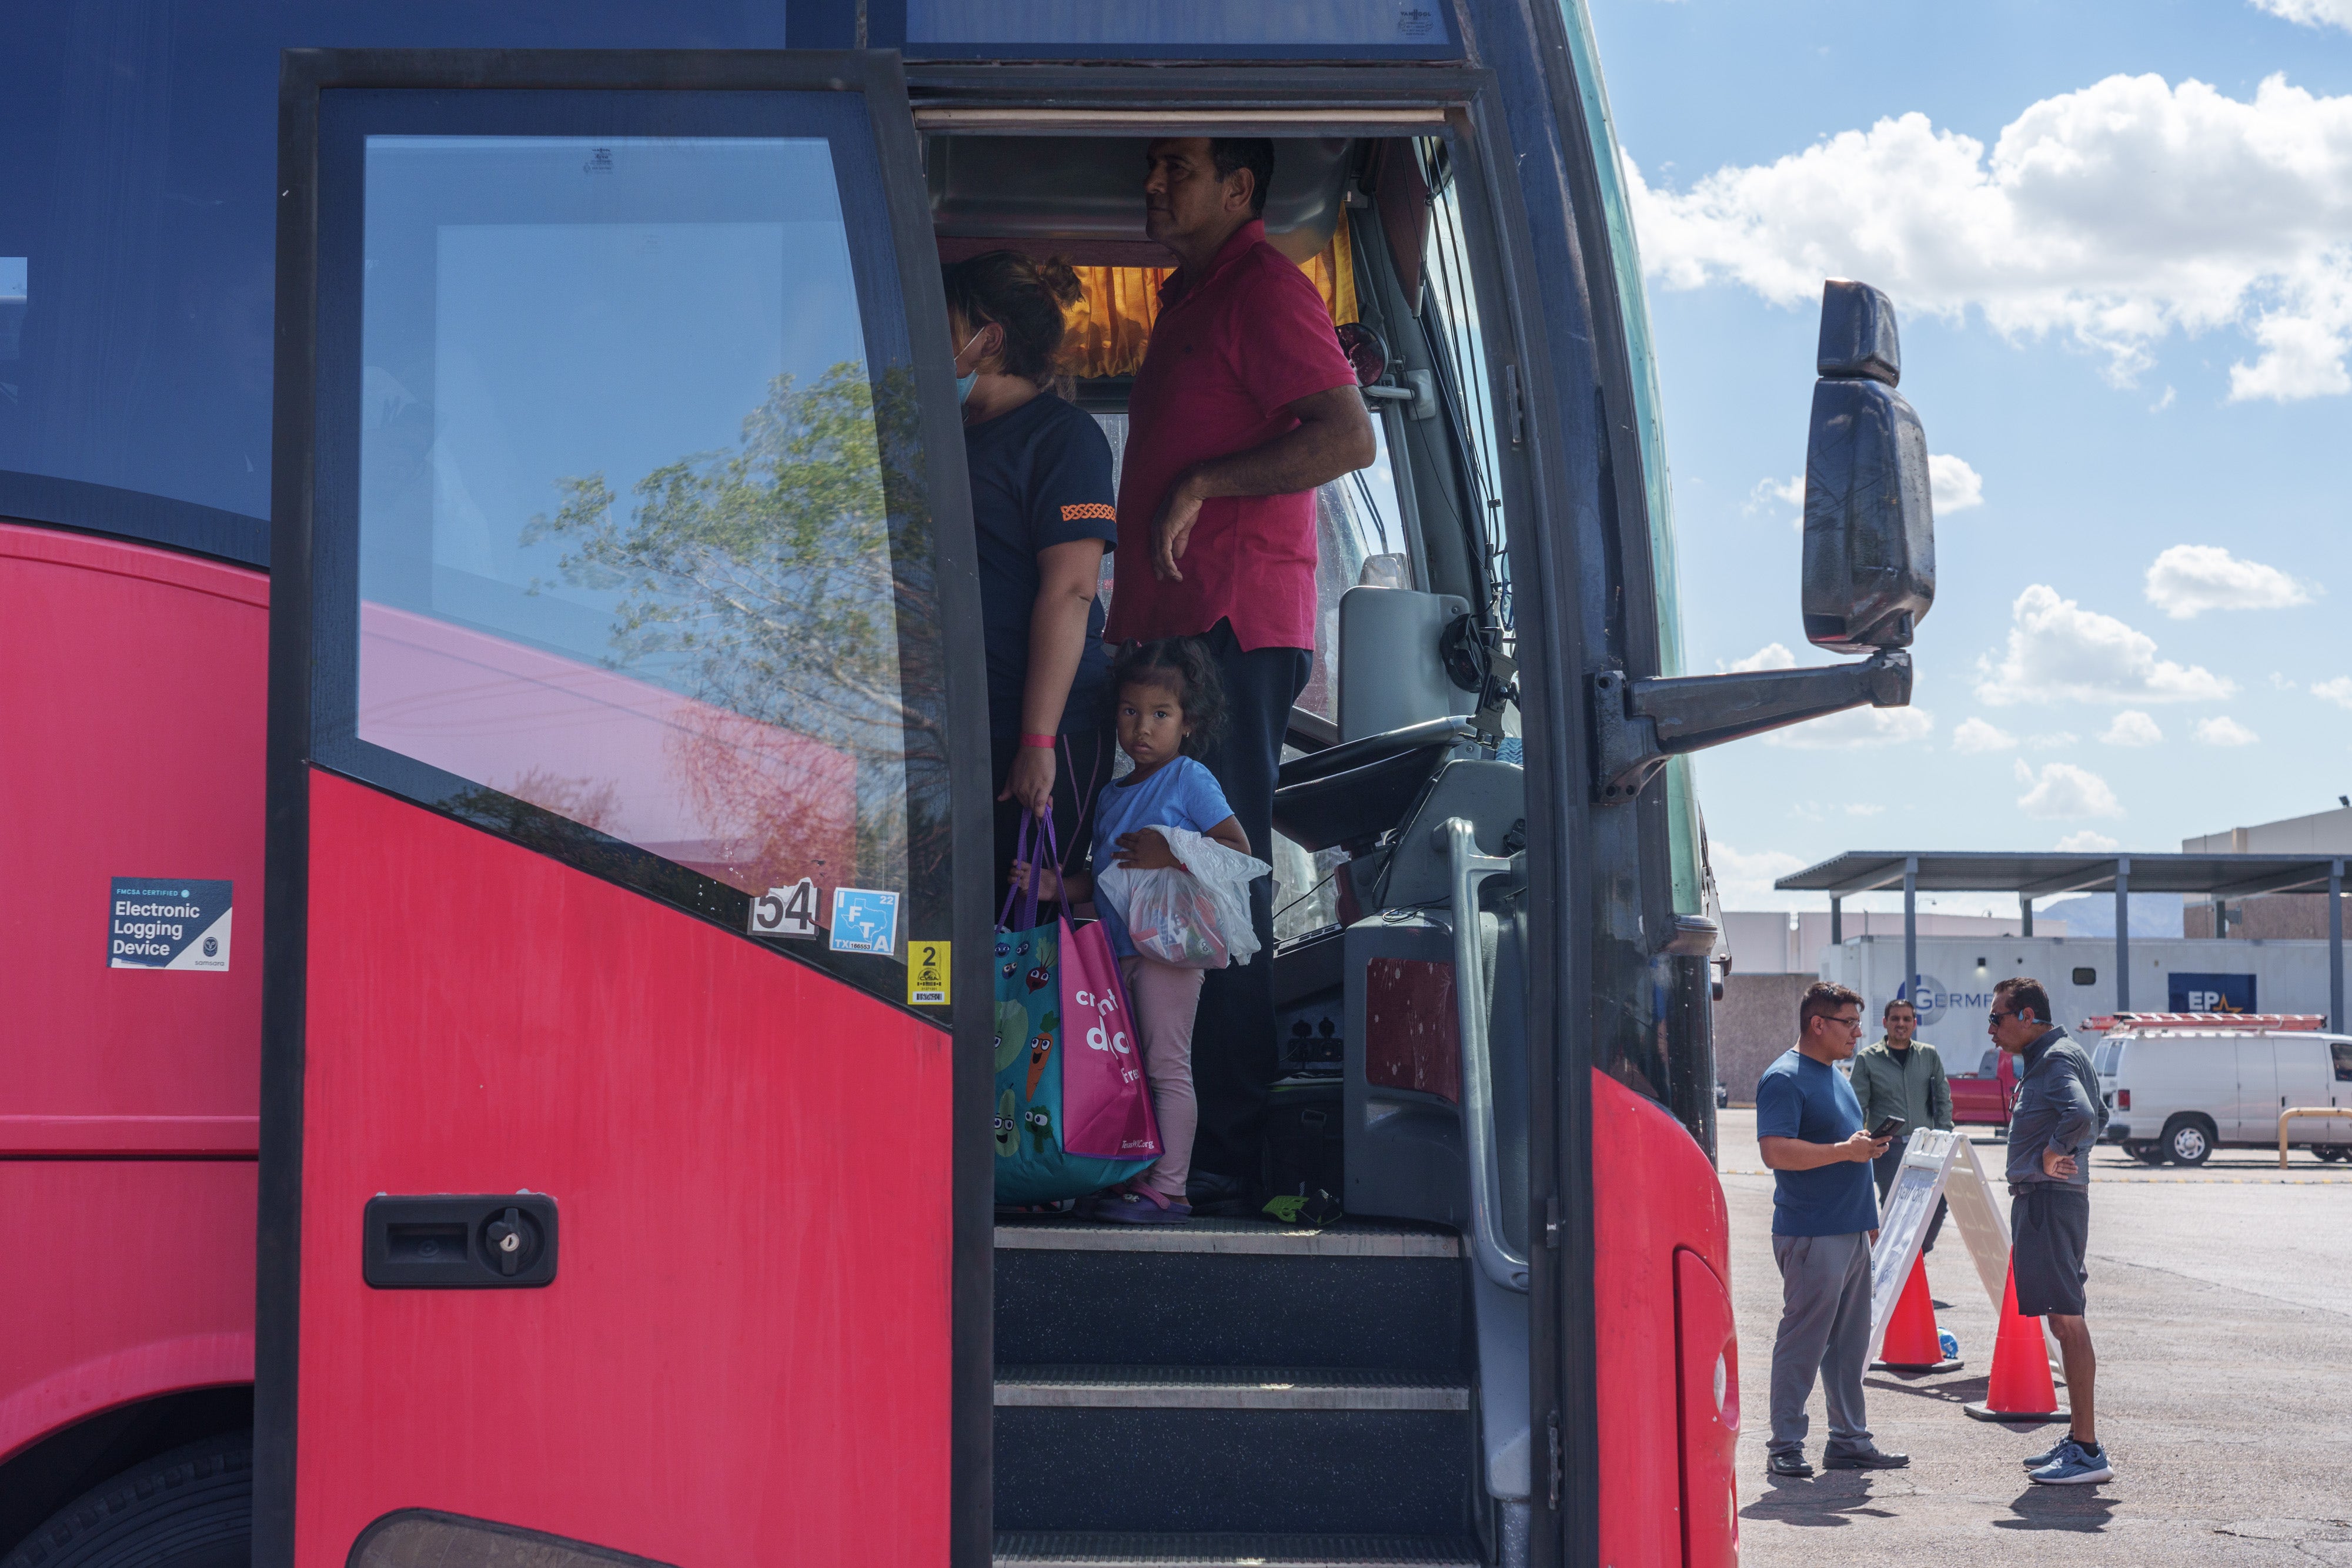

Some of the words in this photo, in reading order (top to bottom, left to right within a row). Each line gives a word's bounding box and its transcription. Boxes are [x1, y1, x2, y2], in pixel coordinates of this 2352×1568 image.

[757, 882, 811, 930] 54
[880, 895, 894, 905] 22
[115, 901, 200, 918] Electronic
[114, 920, 182, 940] Logging
[113, 940, 170, 955] Device
[835, 939, 849, 948] TX
[923, 947, 936, 966] 2
[1122, 1139, 1154, 1149] TexasWIC.org
